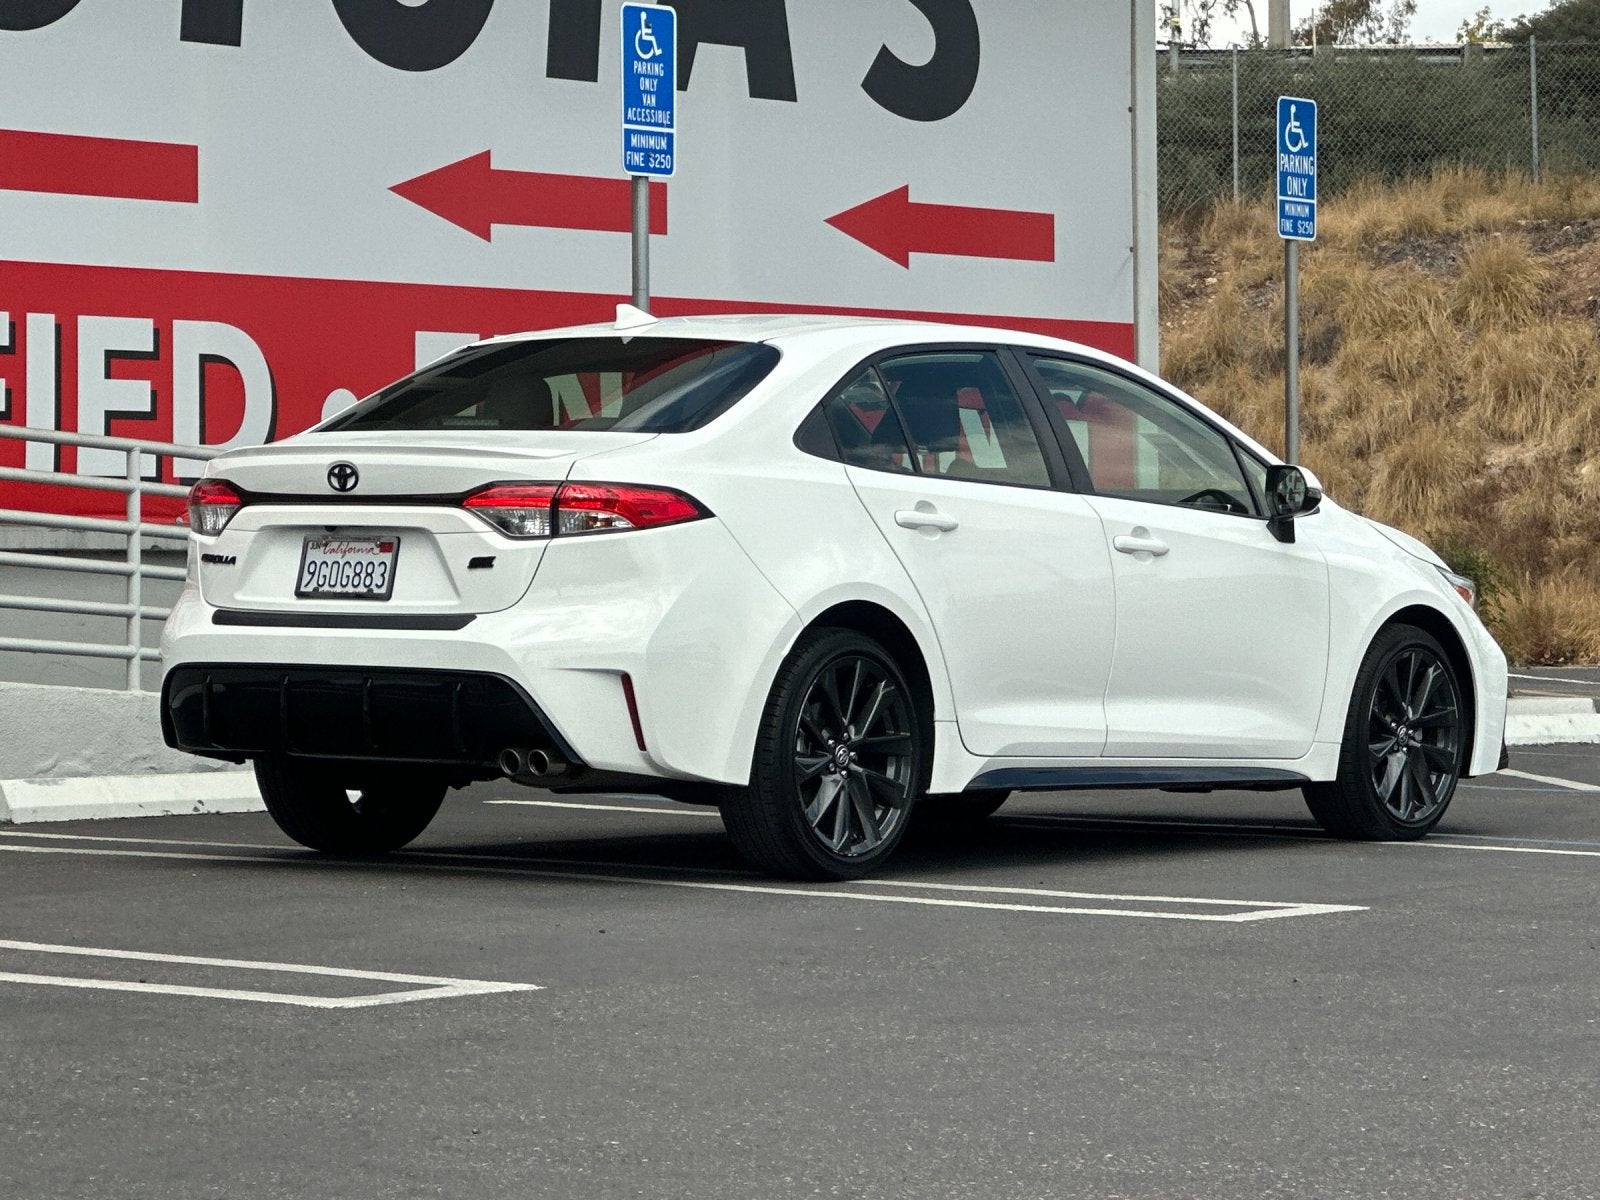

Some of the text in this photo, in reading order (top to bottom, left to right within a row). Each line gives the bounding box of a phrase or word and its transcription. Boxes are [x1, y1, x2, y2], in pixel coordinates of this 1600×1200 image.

[633, 60, 664, 77] PARKING
[640, 76, 658, 91] ONLY
[642, 93, 656, 107] VAN
[627, 107, 671, 124] ACCESSIBLE
[631, 133, 667, 150] MINIMUM
[626, 151, 671, 169] FINE $250
[1280, 153, 1314, 176] PARKING
[1286, 175, 1308, 196] ONLY
[1284, 202, 1310, 218] MINIMUM
[1281, 218, 1314, 235] FINE $250
[0, 312, 275, 480] IED
[322, 541, 380, 558] California
